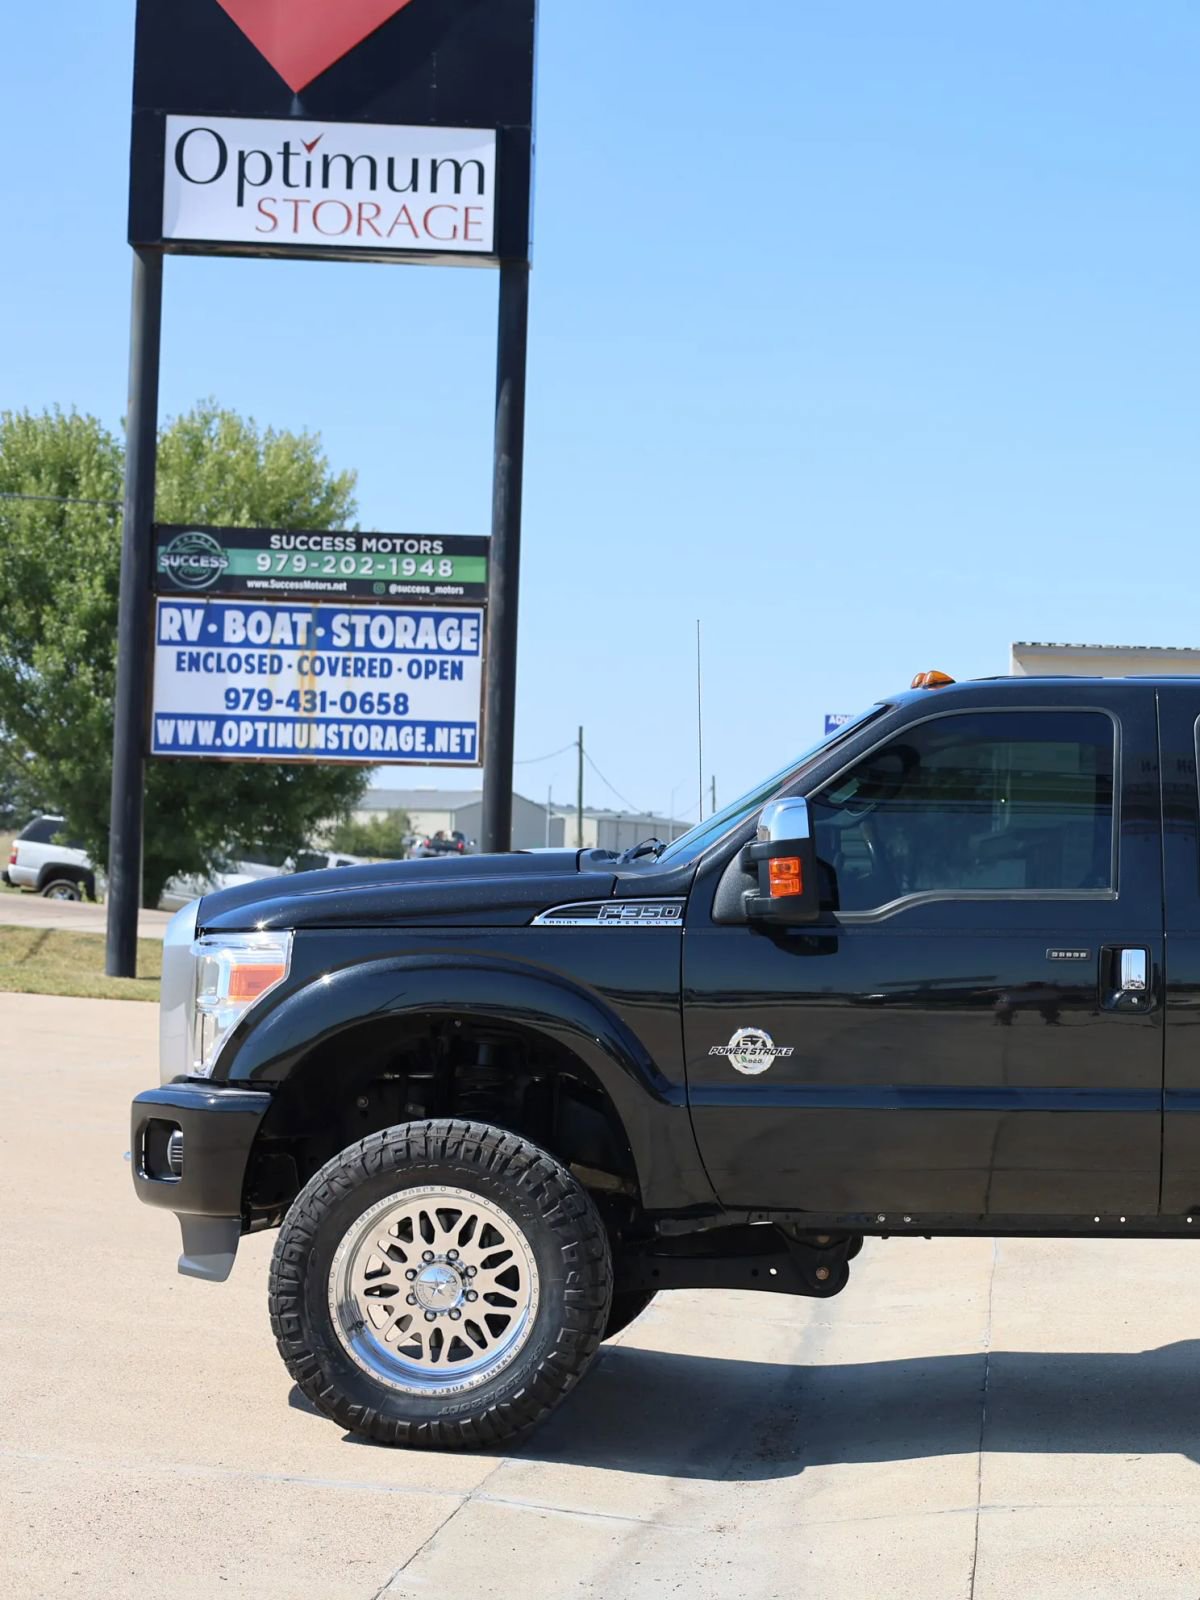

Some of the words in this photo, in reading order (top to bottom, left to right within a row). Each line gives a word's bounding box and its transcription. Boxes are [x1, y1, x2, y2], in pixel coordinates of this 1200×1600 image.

[174, 127, 485, 207] Optimum
[255, 197, 484, 242] STORAGE
[270, 535, 357, 552] SUCCESS
[362, 537, 443, 555] MOTORS
[160, 553, 229, 569] SUCCESS
[256, 554, 454, 577] 979-202-1948
[246, 579, 348, 592] www.SuccessMotors.net
[388, 583, 464, 595] @success_motors
[160, 607, 205, 642] RV
[223, 609, 313, 646] BOAT
[331, 613, 479, 651] STORAGE
[175, 651, 283, 675] ENCLOSED
[297, 655, 393, 679] COVERED
[407, 658, 464, 681] OPEN
[224, 687, 410, 716] 979-431-0658
[156, 719, 475, 754] WWW.OPTIMUMSTORAGE.NET
[709, 1046, 748, 1056] POWER
[749, 1047, 794, 1057] STROKE
